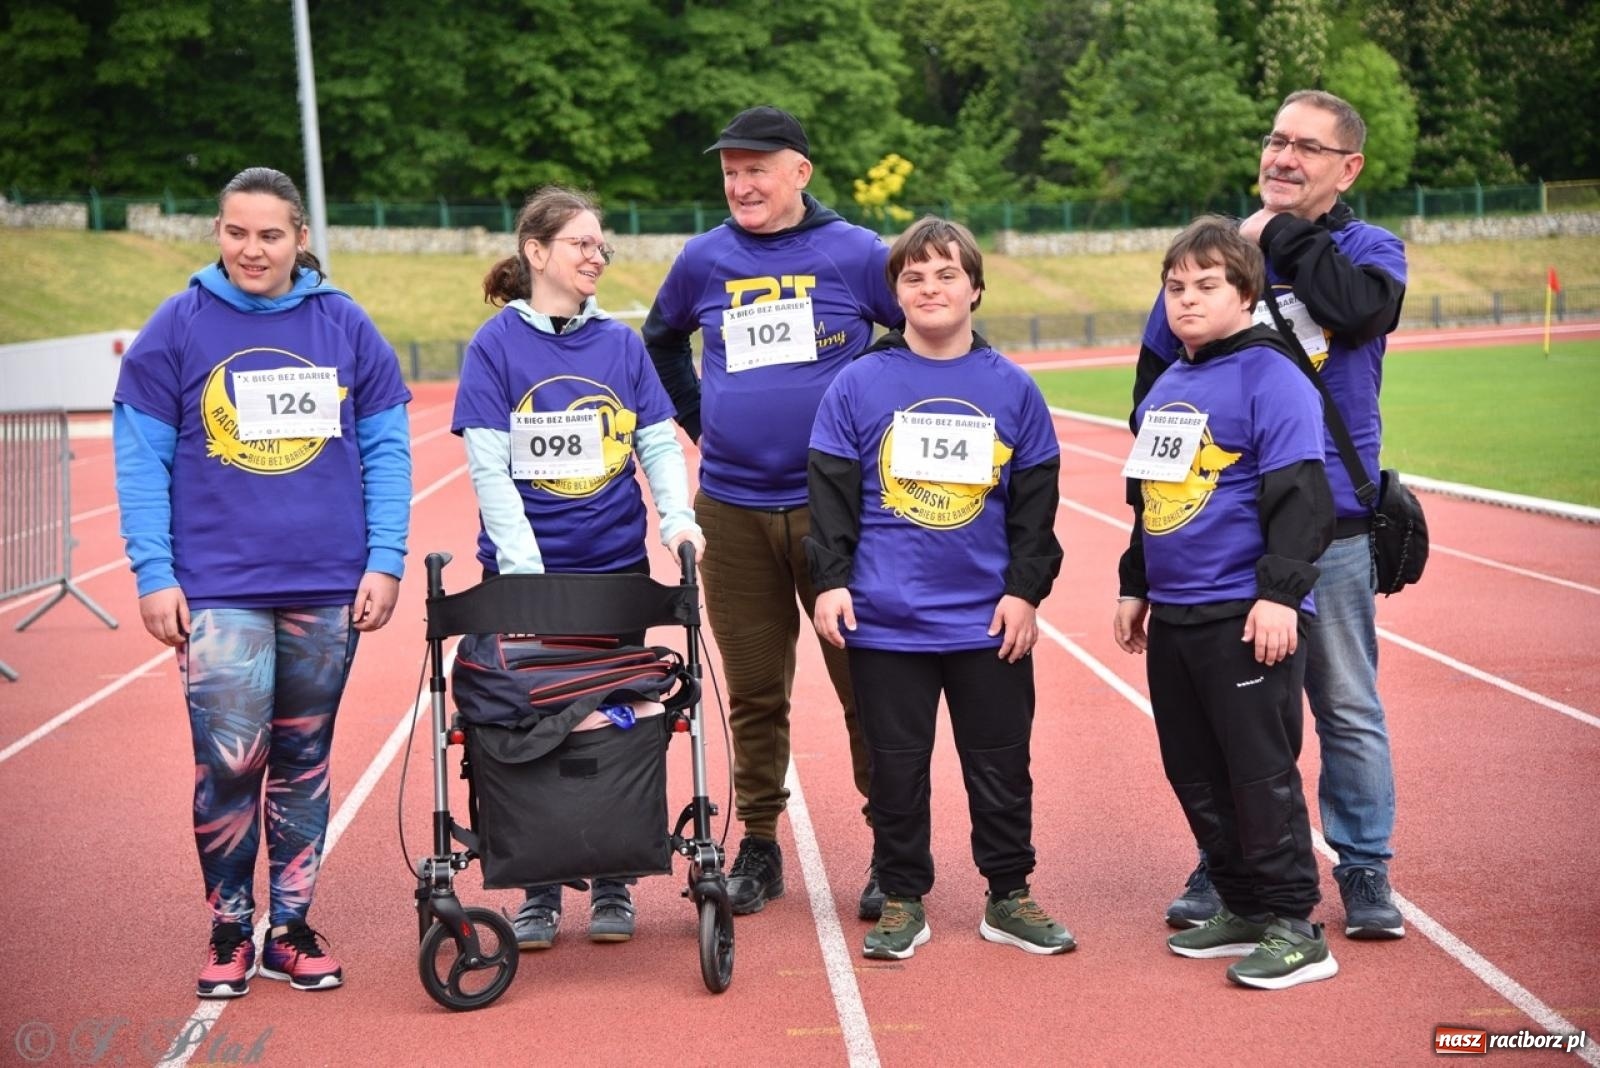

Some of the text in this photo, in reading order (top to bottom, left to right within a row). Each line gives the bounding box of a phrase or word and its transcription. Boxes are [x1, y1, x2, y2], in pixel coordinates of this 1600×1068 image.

[736, 310, 755, 319] BIEG
[757, 306, 772, 314] BEZ
[775, 302, 805, 312] BARIER
[747, 322, 791, 347] 102
[252, 374, 274, 382] BIEG
[278, 372, 296, 381] BEZ
[299, 371, 330, 380] BARIER
[266, 392, 316, 415] 126
[524, 416, 544, 425] BIEG
[547, 415, 563, 423] BEZ
[566, 414, 593, 423] BARIER
[911, 417, 932, 425] BIEG
[936, 418, 952, 426] BEZ
[955, 419, 987, 429] BARIER
[1154, 415, 1167, 424] BIEG
[1168, 416, 1178, 424] BEZ
[1180, 417, 1201, 425] BARIER
[247, 444, 310, 466] BIEG BEZ BARIER
[530, 434, 582, 457] 098
[920, 437, 968, 461] 154
[1150, 436, 1183, 459] 158
[555, 480, 571, 490] BIEG
[574, 480, 587, 490] BEZ
[918, 501, 976, 522] BIEG BEZ BARIER
